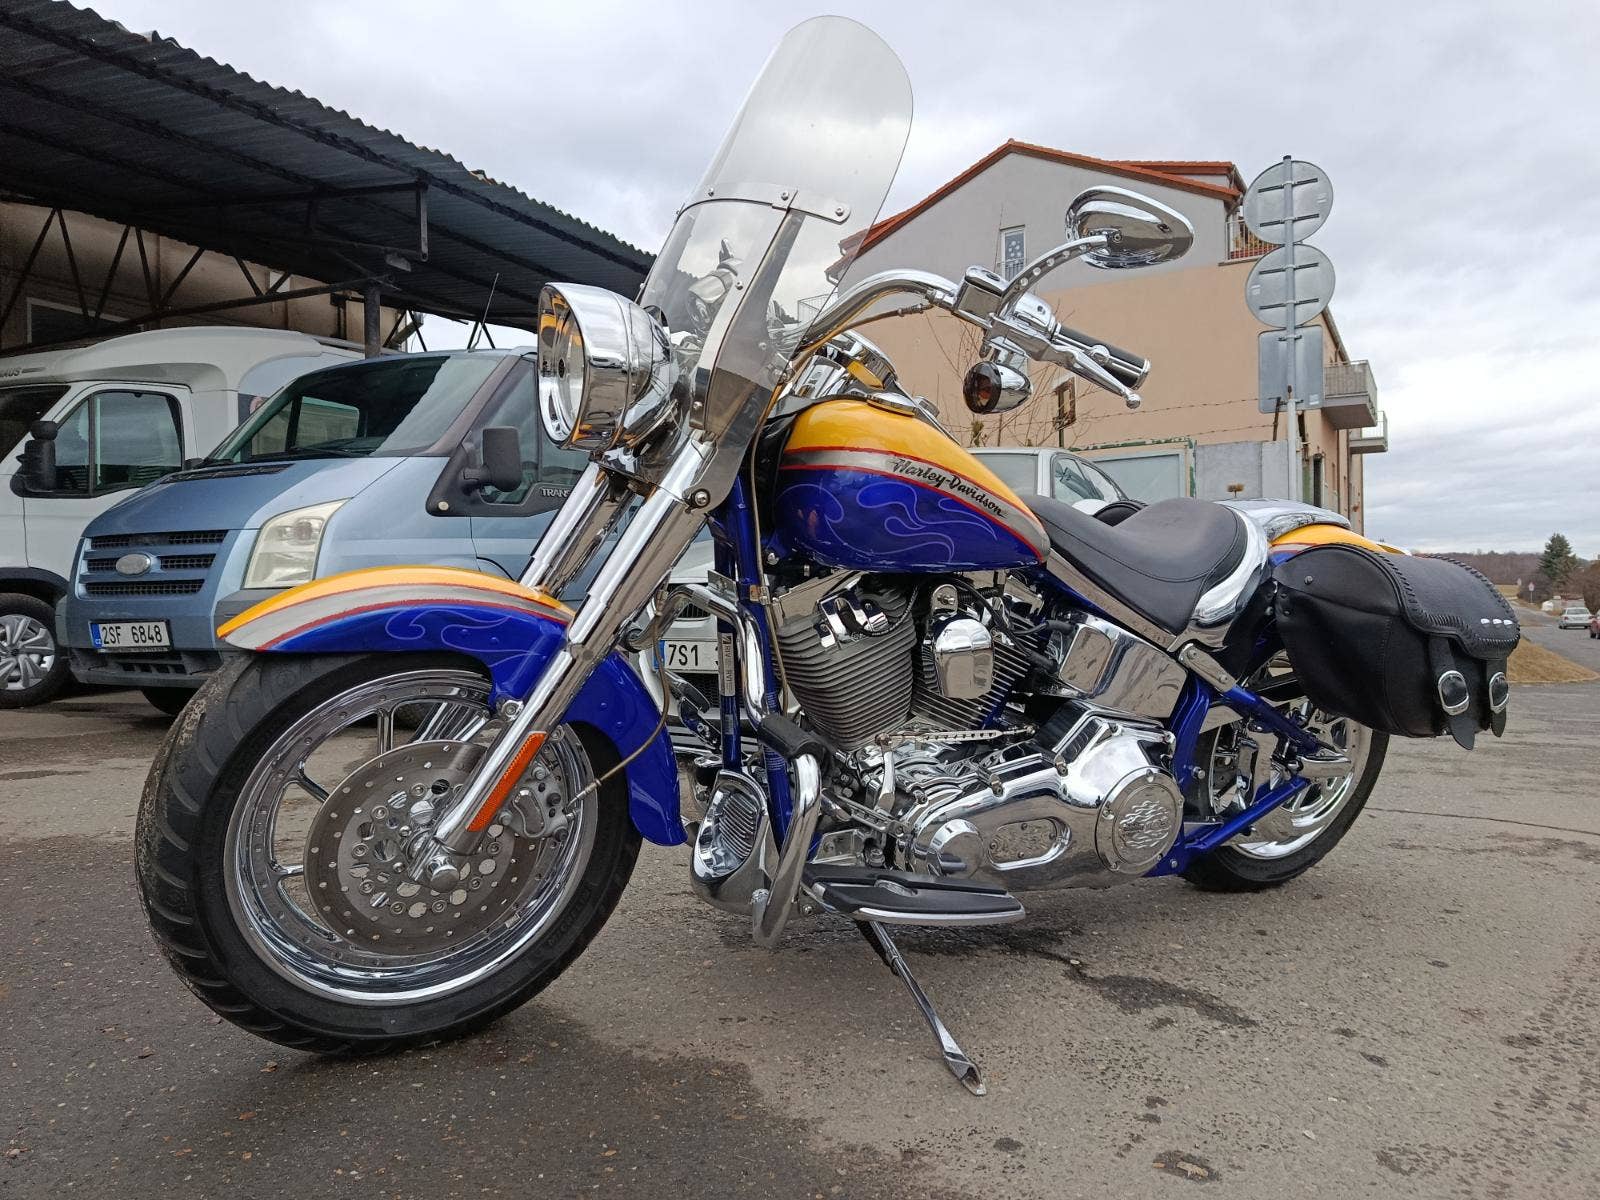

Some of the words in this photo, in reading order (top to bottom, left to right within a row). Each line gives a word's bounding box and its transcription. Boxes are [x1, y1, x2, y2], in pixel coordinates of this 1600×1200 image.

[892, 458, 1006, 519] Harley-Davidson
[102, 625, 121, 644] 2SF
[131, 625, 162, 643] 6848
[668, 644, 698, 666] 7S1
